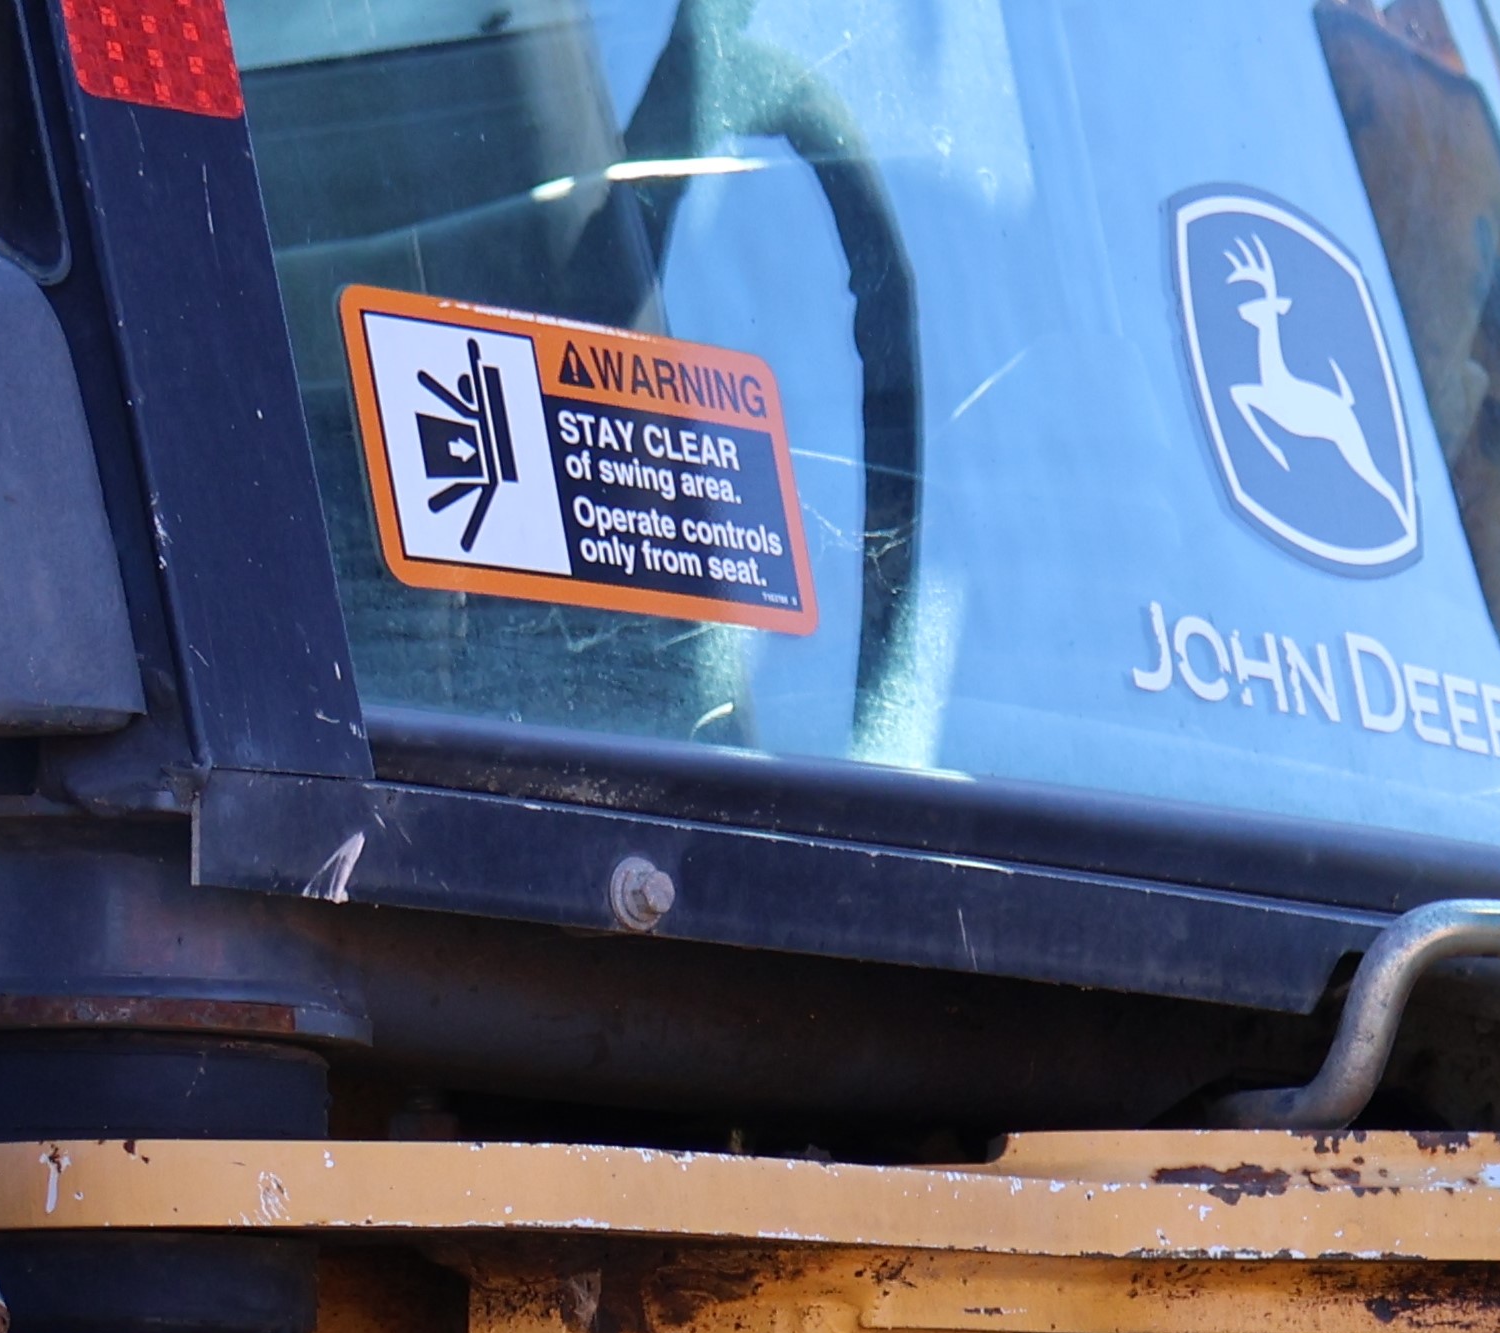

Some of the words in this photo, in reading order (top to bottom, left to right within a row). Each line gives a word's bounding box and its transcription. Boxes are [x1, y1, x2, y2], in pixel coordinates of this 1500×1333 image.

[590, 346, 768, 419] WARNING
[558, 410, 634, 453] STAY
[643, 423, 740, 471] CLEAR
[565, 449, 593, 481] of
[599, 457, 676, 501] swing
[680, 471, 742, 505] area.
[573, 495, 676, 537] Operate
[682, 517, 784, 557] controls
[580, 535, 635, 576] only
[642, 540, 703, 578] from
[707, 556, 768, 587] seat.
[1132, 602, 1341, 722] JOHN
